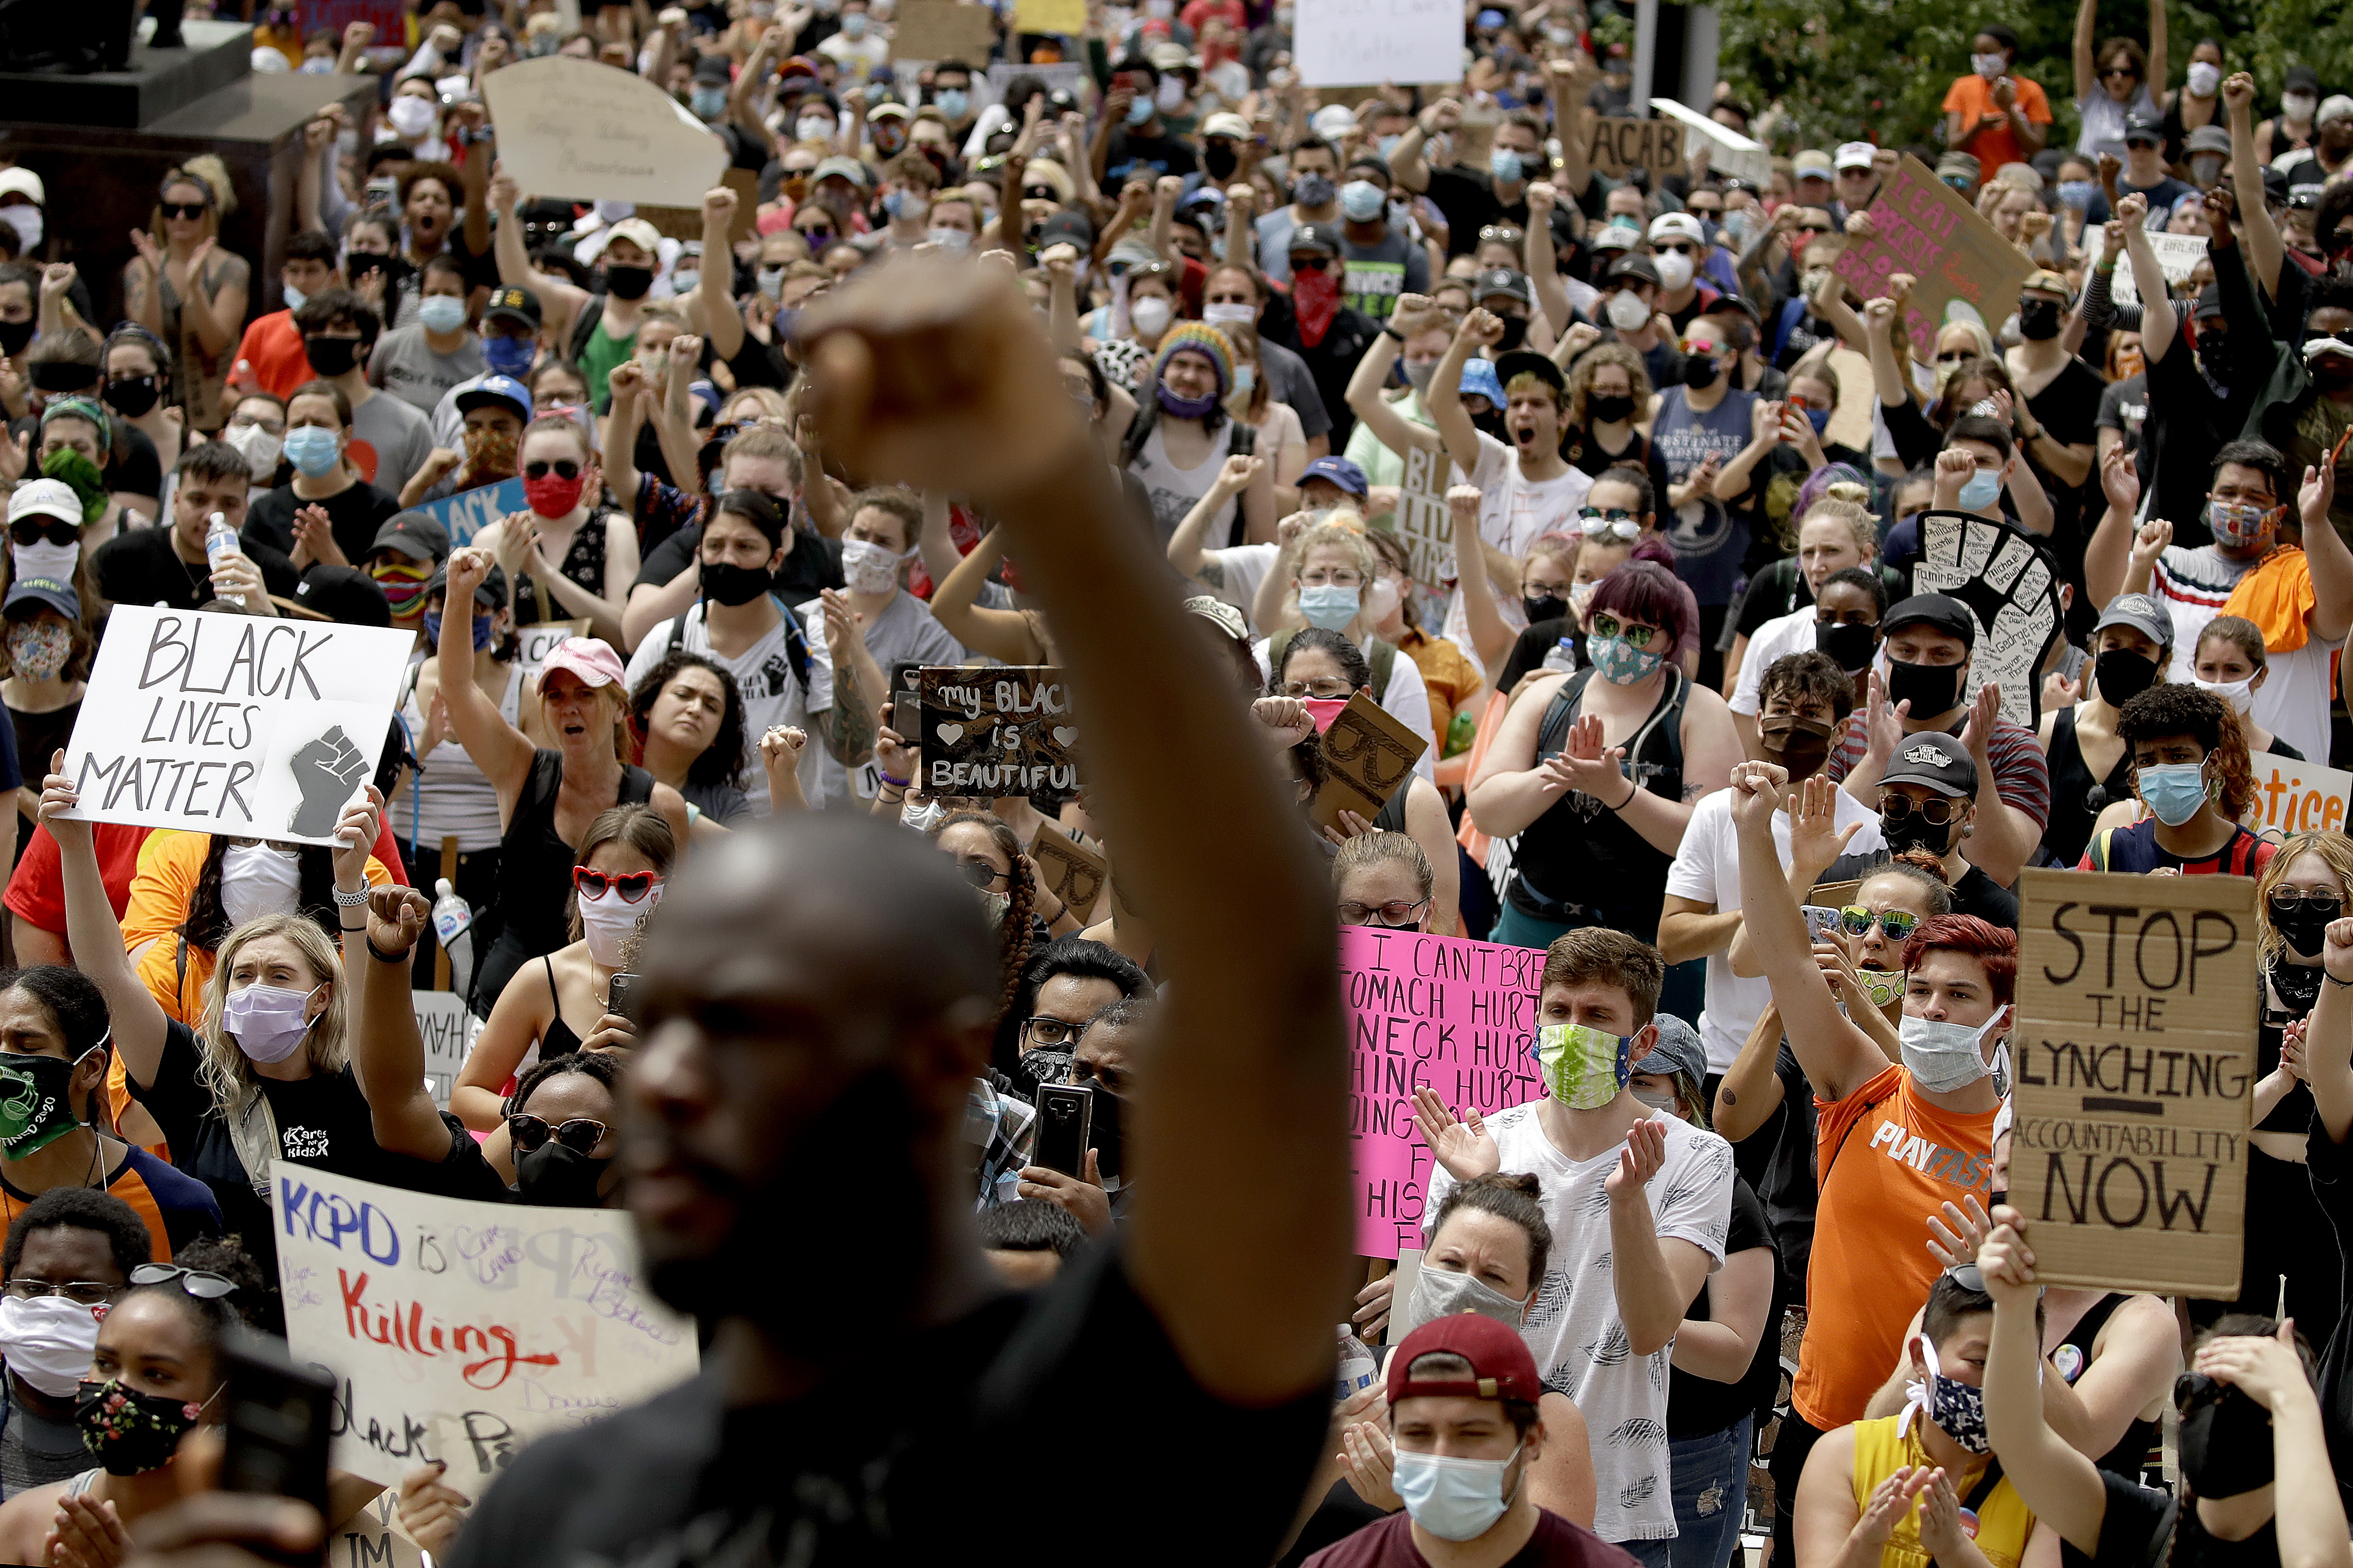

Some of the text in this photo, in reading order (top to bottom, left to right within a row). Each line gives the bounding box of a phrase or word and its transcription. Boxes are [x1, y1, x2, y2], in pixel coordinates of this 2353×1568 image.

[1588, 121, 1679, 168] ACAB
[1888, 170, 1964, 239] I EAT
[427, 486, 506, 543] ACK
[1926, 523, 1962, 539] Philando
[1925, 537, 1955, 551] Castile
[1947, 573, 1965, 586] Rice
[1995, 566, 2020, 586] Brown
[2009, 616, 2027, 625] Davis
[2121, 599, 2153, 613] BOULEVARD
[1996, 626, 2031, 653] George
[2029, 611, 2054, 636] Floyd
[138, 616, 333, 701] BLACK
[141, 696, 261, 750] LIVES
[938, 685, 981, 720] my
[992, 717, 1021, 750] is
[1919, 746, 1936, 754] VANS
[1920, 752, 1932, 761] THE
[71, 751, 254, 822] MATTER
[932, 761, 1086, 791] BEAUTIFUL
[1370, 934, 1391, 971] I
[1414, 938, 1495, 984] CAN'T
[2043, 902, 2239, 995] STOP
[2086, 994, 2167, 1032] THE
[1356, 1012, 1536, 1078] NECK HUR
[2019, 1037, 2251, 1100] LYNCHING
[2011, 1115, 2242, 1161] ACCOUNTABILITY
[2037, 1151, 2221, 1233] NOW
[281, 1176, 447, 1274] KCPD is
[337, 1266, 561, 1391] Killing
